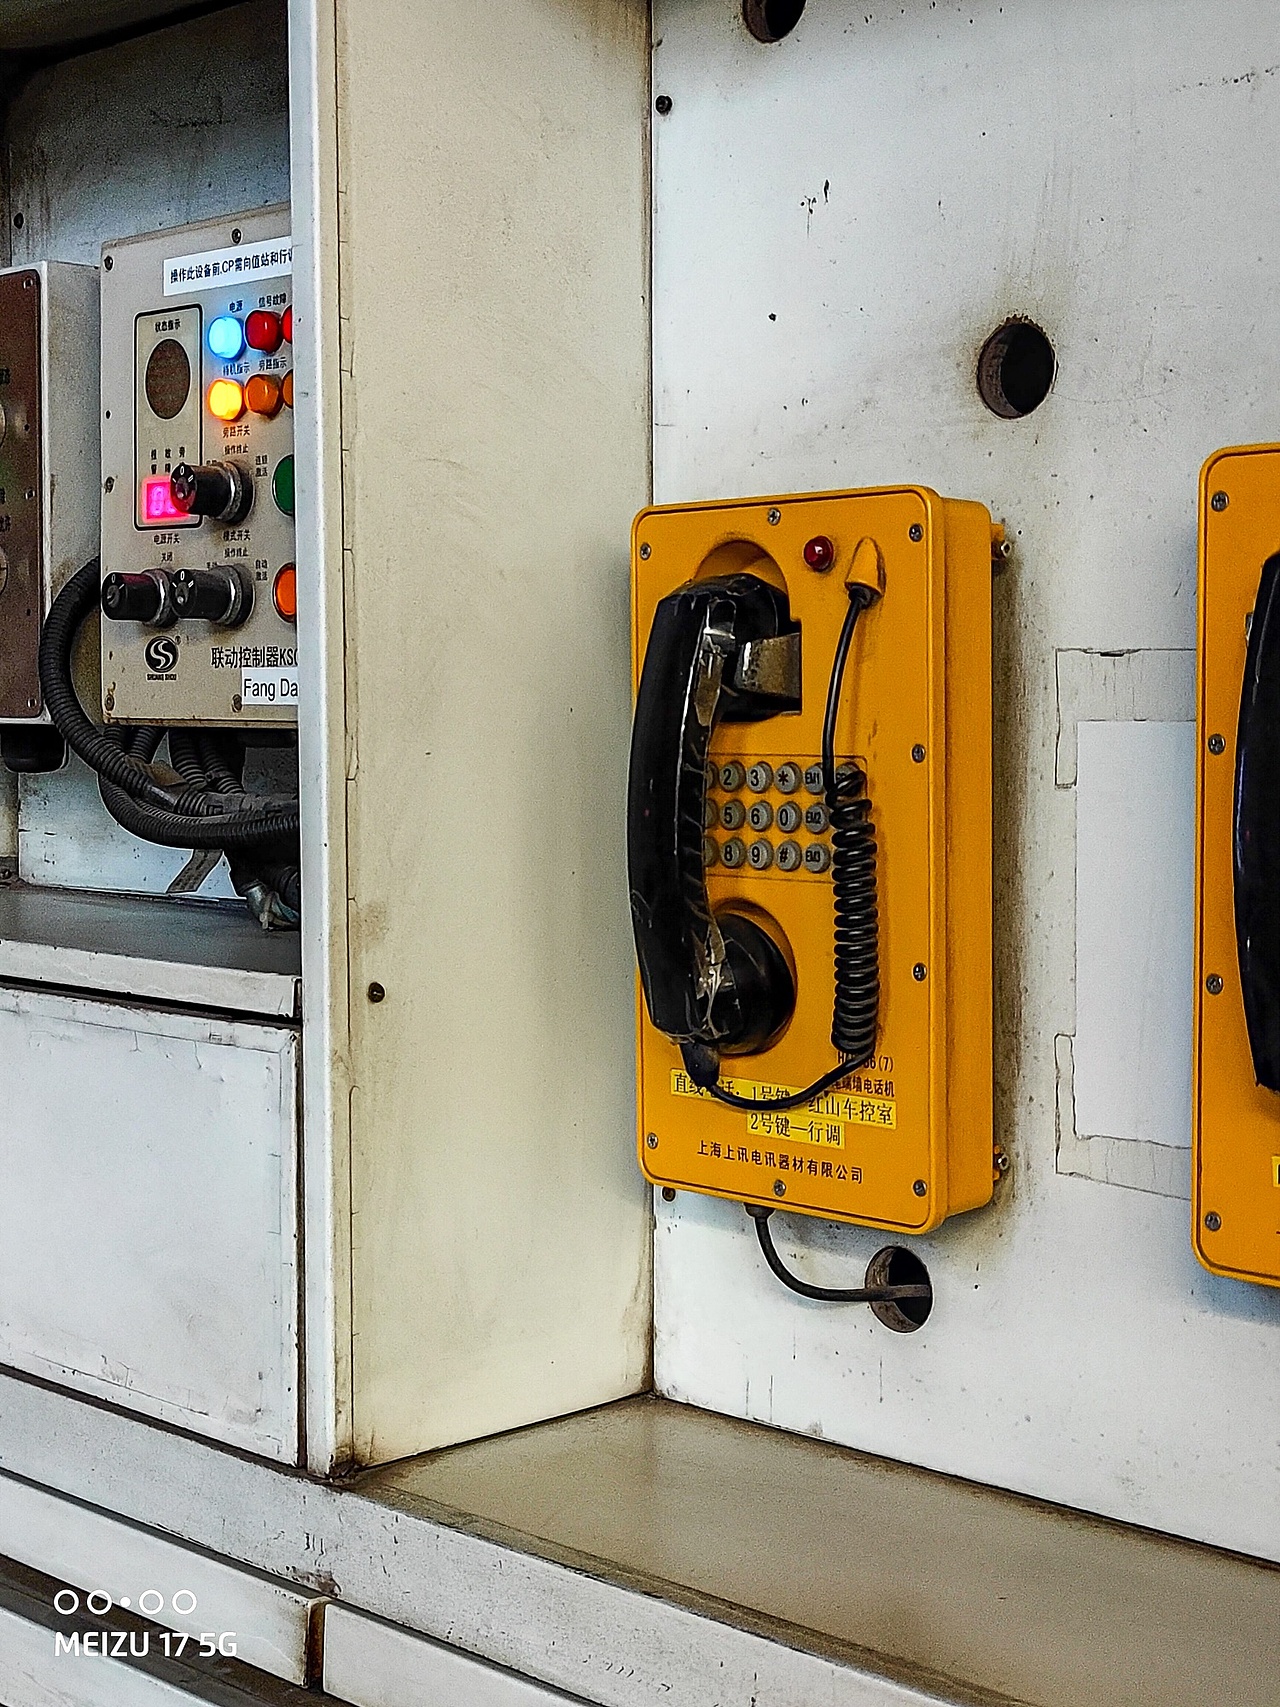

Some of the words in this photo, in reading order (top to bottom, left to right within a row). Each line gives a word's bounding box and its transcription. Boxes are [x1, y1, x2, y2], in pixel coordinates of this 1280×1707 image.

[244, 678, 275, 701] Fang
[723, 768, 732, 786] 2
[750, 769, 759, 787] 3
[724, 807, 733, 824] 5
[751, 808, 760, 825] 6
[779, 808, 788, 826] 0
[724, 845, 733, 862] 8
[751, 846, 760, 863] 9
[697, 1140, 863, 1184] 上海上讯电讯器材有限公司
